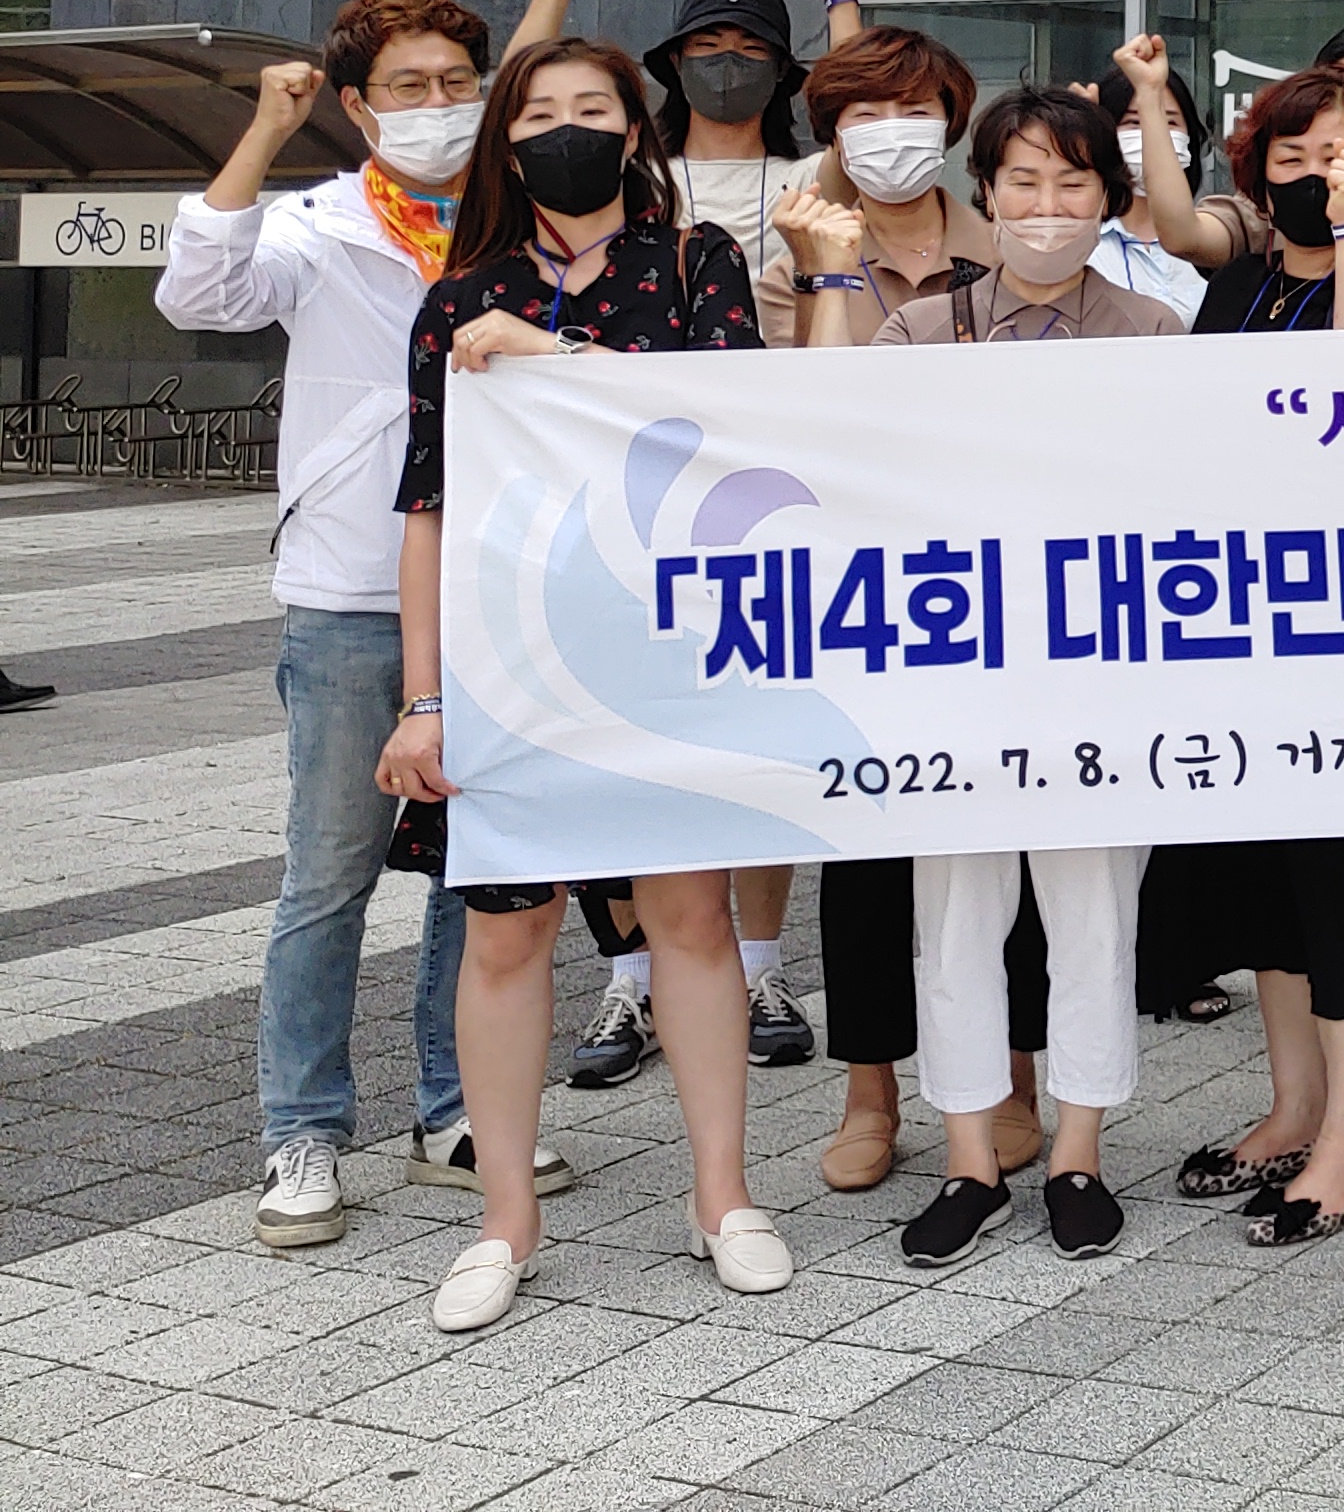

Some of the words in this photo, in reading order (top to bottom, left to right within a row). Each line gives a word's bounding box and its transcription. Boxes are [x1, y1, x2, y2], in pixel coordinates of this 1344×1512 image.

[819, 751, 975, 800] 2022.
[1002, 748, 1048, 790] 7.
[1074, 742, 1121, 789] 8.
[1149, 730, 1248, 792] (금)
